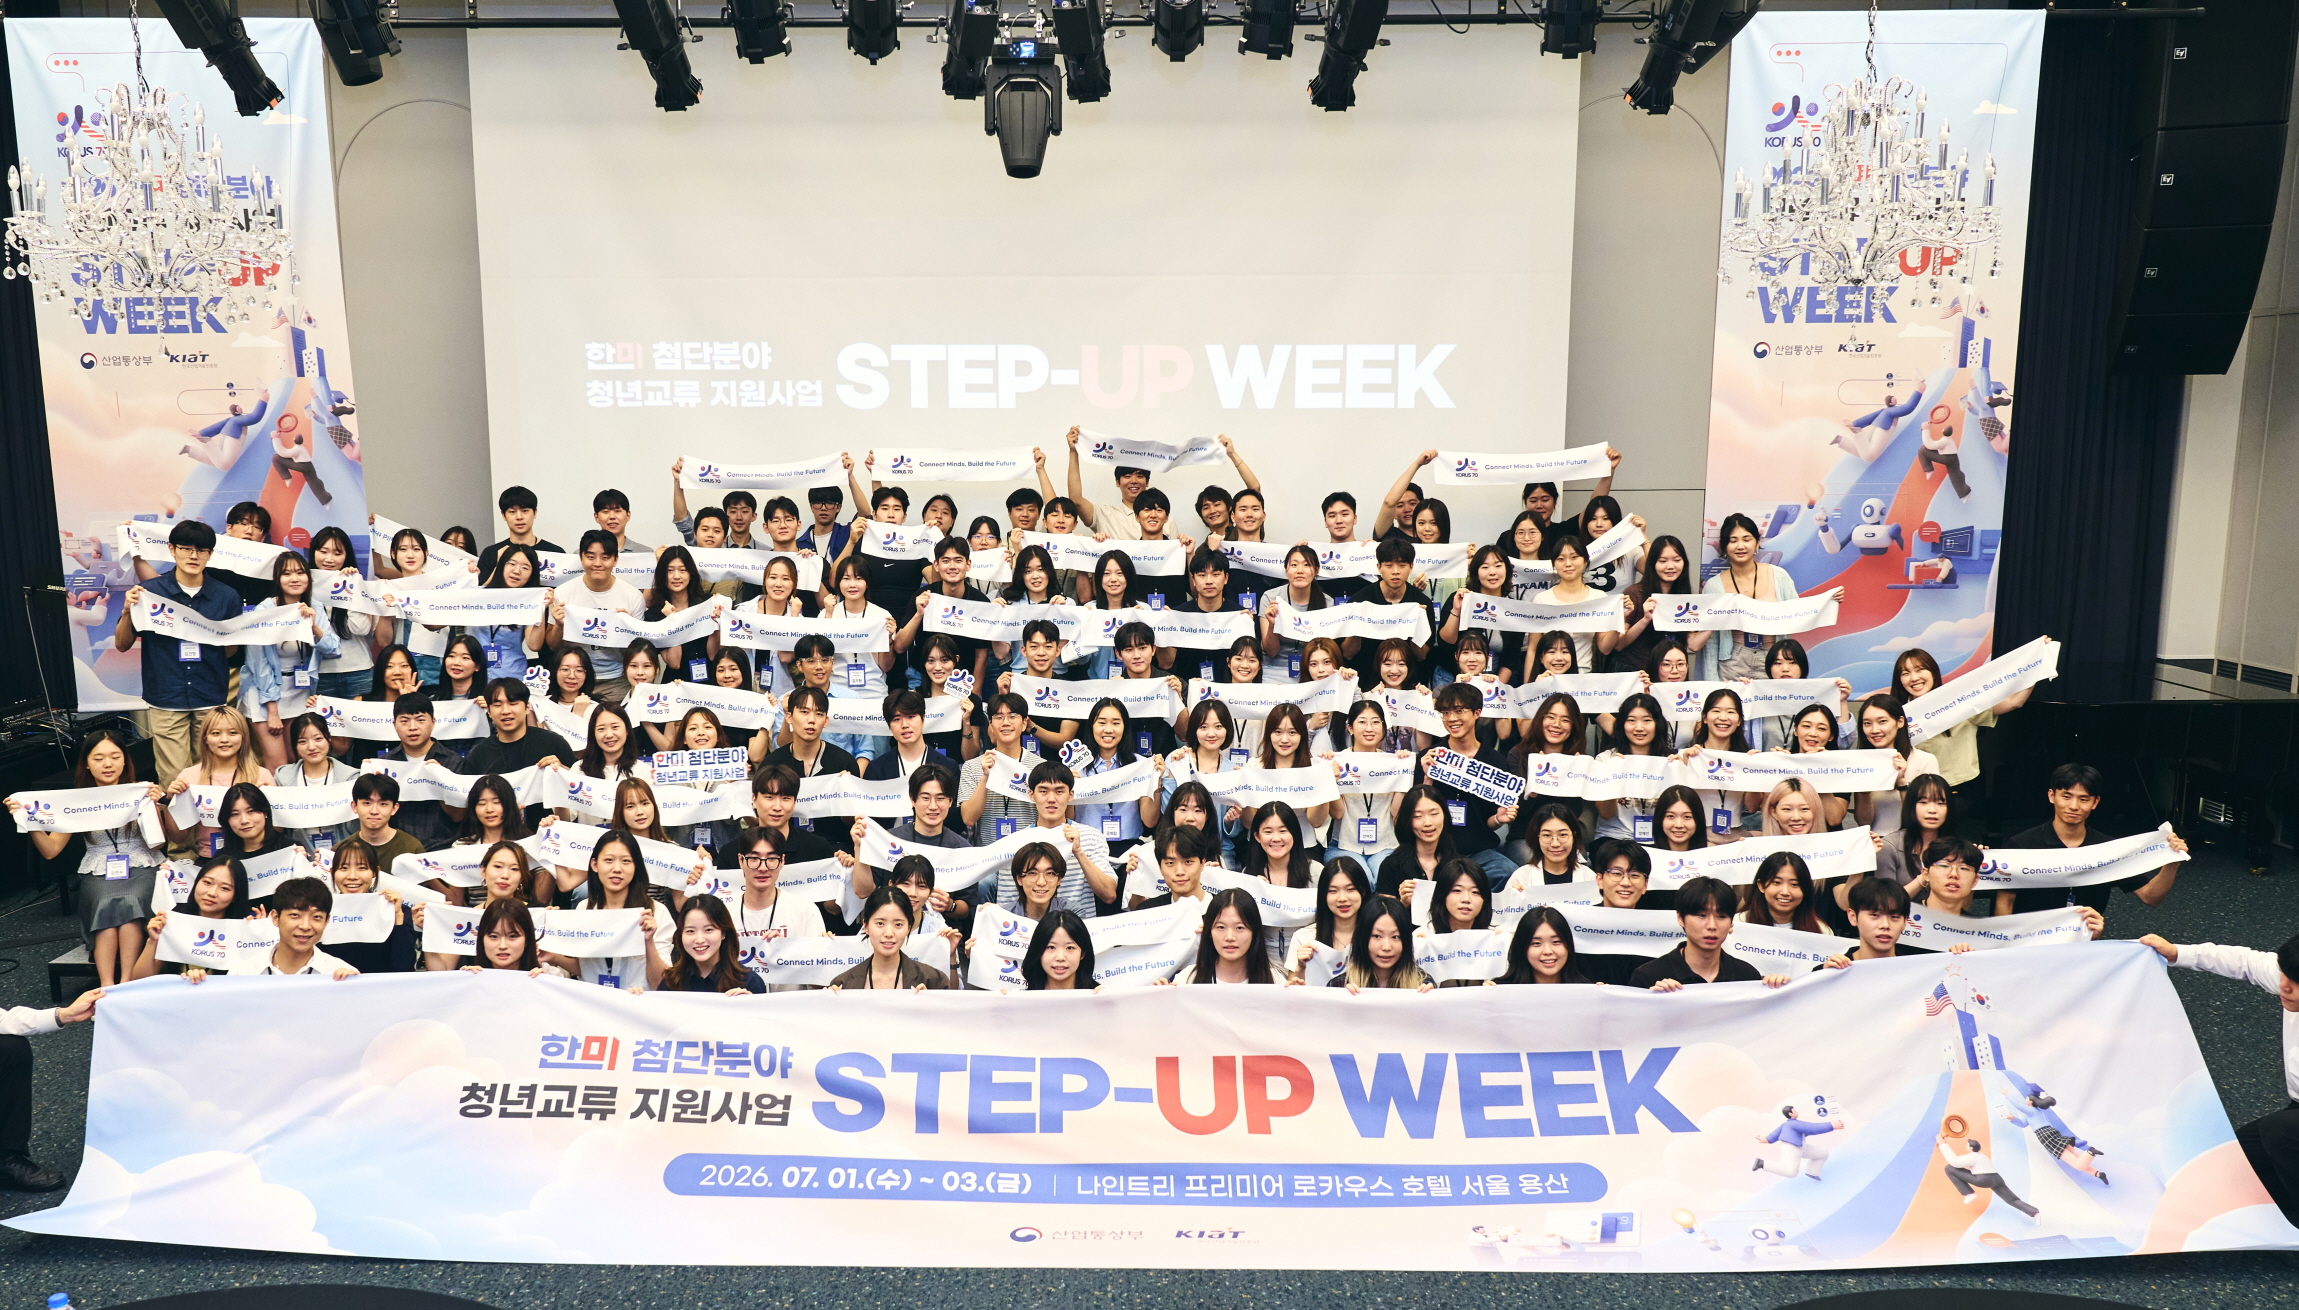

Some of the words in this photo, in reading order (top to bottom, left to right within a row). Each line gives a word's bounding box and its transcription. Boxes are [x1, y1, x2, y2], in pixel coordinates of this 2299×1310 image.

[1757, 286, 1899, 324] WEEK
[73, 297, 228, 334] WEEK
[585, 341, 643, 370] 한미
[652, 341, 772, 370] 첨단분야
[1775, 344, 1823, 356] 산업통상부
[102, 355, 153, 366] 산업통상부
[835, 342, 1194, 409] STEP-UP
[1205, 344, 1457, 409] WEEK
[586, 380, 701, 408] 청년교류
[710, 379, 823, 407] 지원사업
[1566, 458, 1588, 466] Future
[461, 603, 485, 611] Minds,
[1504, 610, 1534, 620] Connect
[1559, 611, 1577, 619] Build
[1707, 608, 1737, 616] Connect
[1761, 614, 1780, 622] Build
[1794, 608, 1819, 618] Future
[275, 619, 300, 627] Future
[760, 629, 789, 637] Connect
[1211, 627, 1232, 635] Future
[1924, 699, 1957, 720] Connect
[1983, 678, 2004, 692] Build
[2004, 671, 2017, 683] the
[676, 697, 702, 707] Connect
[703, 701, 726, 710] Minds,
[655, 753, 684, 768] 한미
[689, 750, 746, 767] 첨단분야
[656, 770, 700, 784] 청년교류
[702, 768, 745, 780] 지원사업
[1435, 749, 1465, 771] 한미
[1465, 760, 1524, 794] 첨단분야
[1429, 766, 1472, 791] 청년교류
[1472, 784, 1516, 807] 지원사업
[820, 793, 842, 801] Minds,
[844, 791, 862, 799] Build
[63, 805, 102, 815] Connect
[103, 802, 132, 811] Minds,
[326, 798, 349, 808] Future
[332, 914, 363, 923] Future
[1574, 926, 1614, 935] Connect
[1616, 929, 1647, 937] Minds,
[1933, 923, 1975, 936] Connect
[1977, 930, 2011, 941] Minds,
[236, 940, 275, 949] Connect
[1457, 950, 1472, 958] the
[1474, 949, 1502, 957] Future
[1734, 943, 1775, 956] Connect
[1778, 949, 1810, 961] Minds,
[777, 958, 814, 966] Connect
[1105, 968, 1126, 978] Build
[1128, 965, 1143, 975] the
[1145, 959, 1175, 969] Future
[538, 1033, 620, 1071] 한미
[631, 1038, 794, 1079] 첨단분야
[811, 1051, 1315, 1135] STEP-UP
[1329, 1046, 1701, 1139] WEEK
[458, 1082, 618, 1122] 청년교류
[629, 1086, 793, 1127] 지원사업
[699, 1164, 773, 1187] 2026.
[782, 1166, 821, 1189] 07.
[827, 1166, 912, 1194] 01.(수)
[941, 1171, 1032, 1196] 03.(금)
[1077, 1174, 1176, 1199] 나인트리
[1184, 1174, 1285, 1199] 프리미어
[1293, 1174, 1395, 1199] 로카우스
[1402, 1174, 1454, 1198] 호텔
[1461, 1174, 1512, 1198] 서울
[1519, 1172, 1570, 1196] 용산
[1051, 1230, 1144, 1241] 산업통상부
